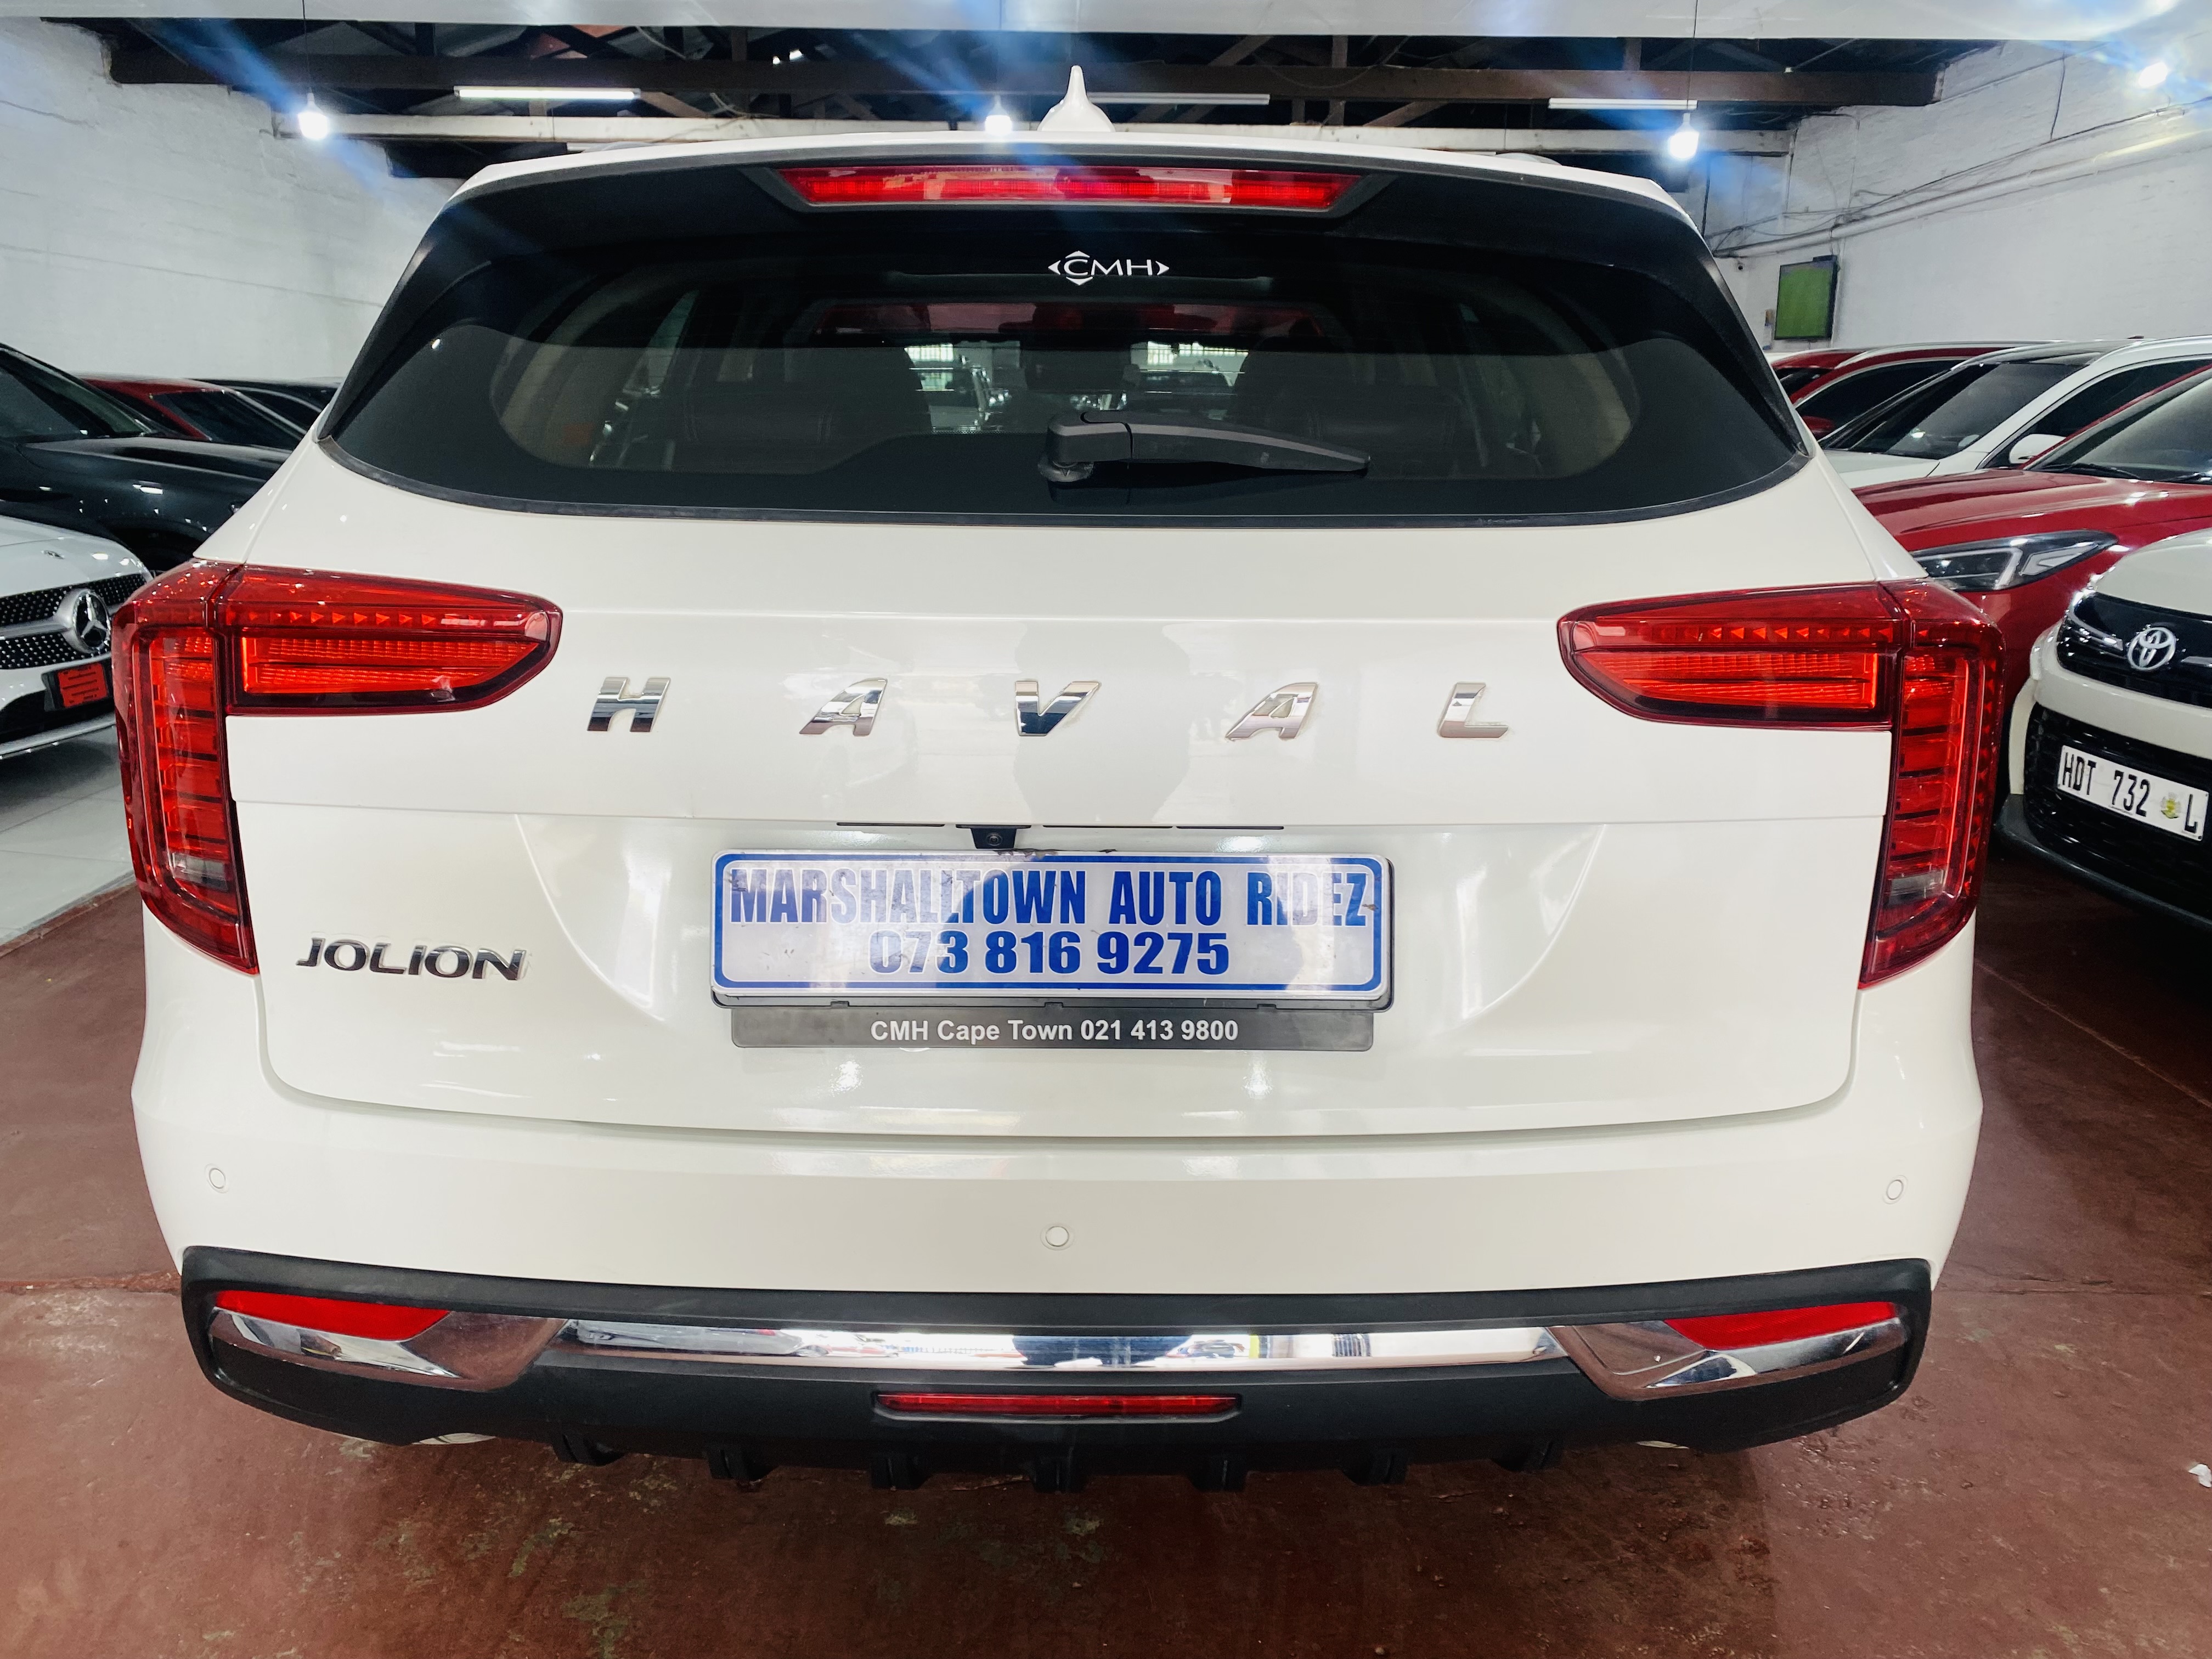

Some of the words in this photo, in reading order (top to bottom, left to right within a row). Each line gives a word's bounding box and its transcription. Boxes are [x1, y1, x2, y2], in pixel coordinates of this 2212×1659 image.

[1064, 258, 1153, 275] CMH
[587, 677, 1509, 741] HAVAL
[2062, 752, 2097, 795] HDT
[2112, 770, 2151, 817] 732
[2185, 794, 2198, 834] L
[730, 868, 1086, 924] MARSHALLTOWN
[1108, 870, 1222, 926] AUTO
[1246, 871, 1367, 927] RIDEZ
[296, 937, 527, 981] JOLION
[869, 930, 969, 974] 073
[985, 930, 1081, 975] 816
[1097, 930, 1229, 975] 9275
[870, 1019, 929, 1041] CMH
[936, 1019, 1001, 1045] Cape
[1007, 1019, 1073, 1041] Town
[1080, 1019, 1121, 1041] 021
[1130, 1019, 1174, 1041] 413
[1181, 1019, 1239, 1041] 9800
